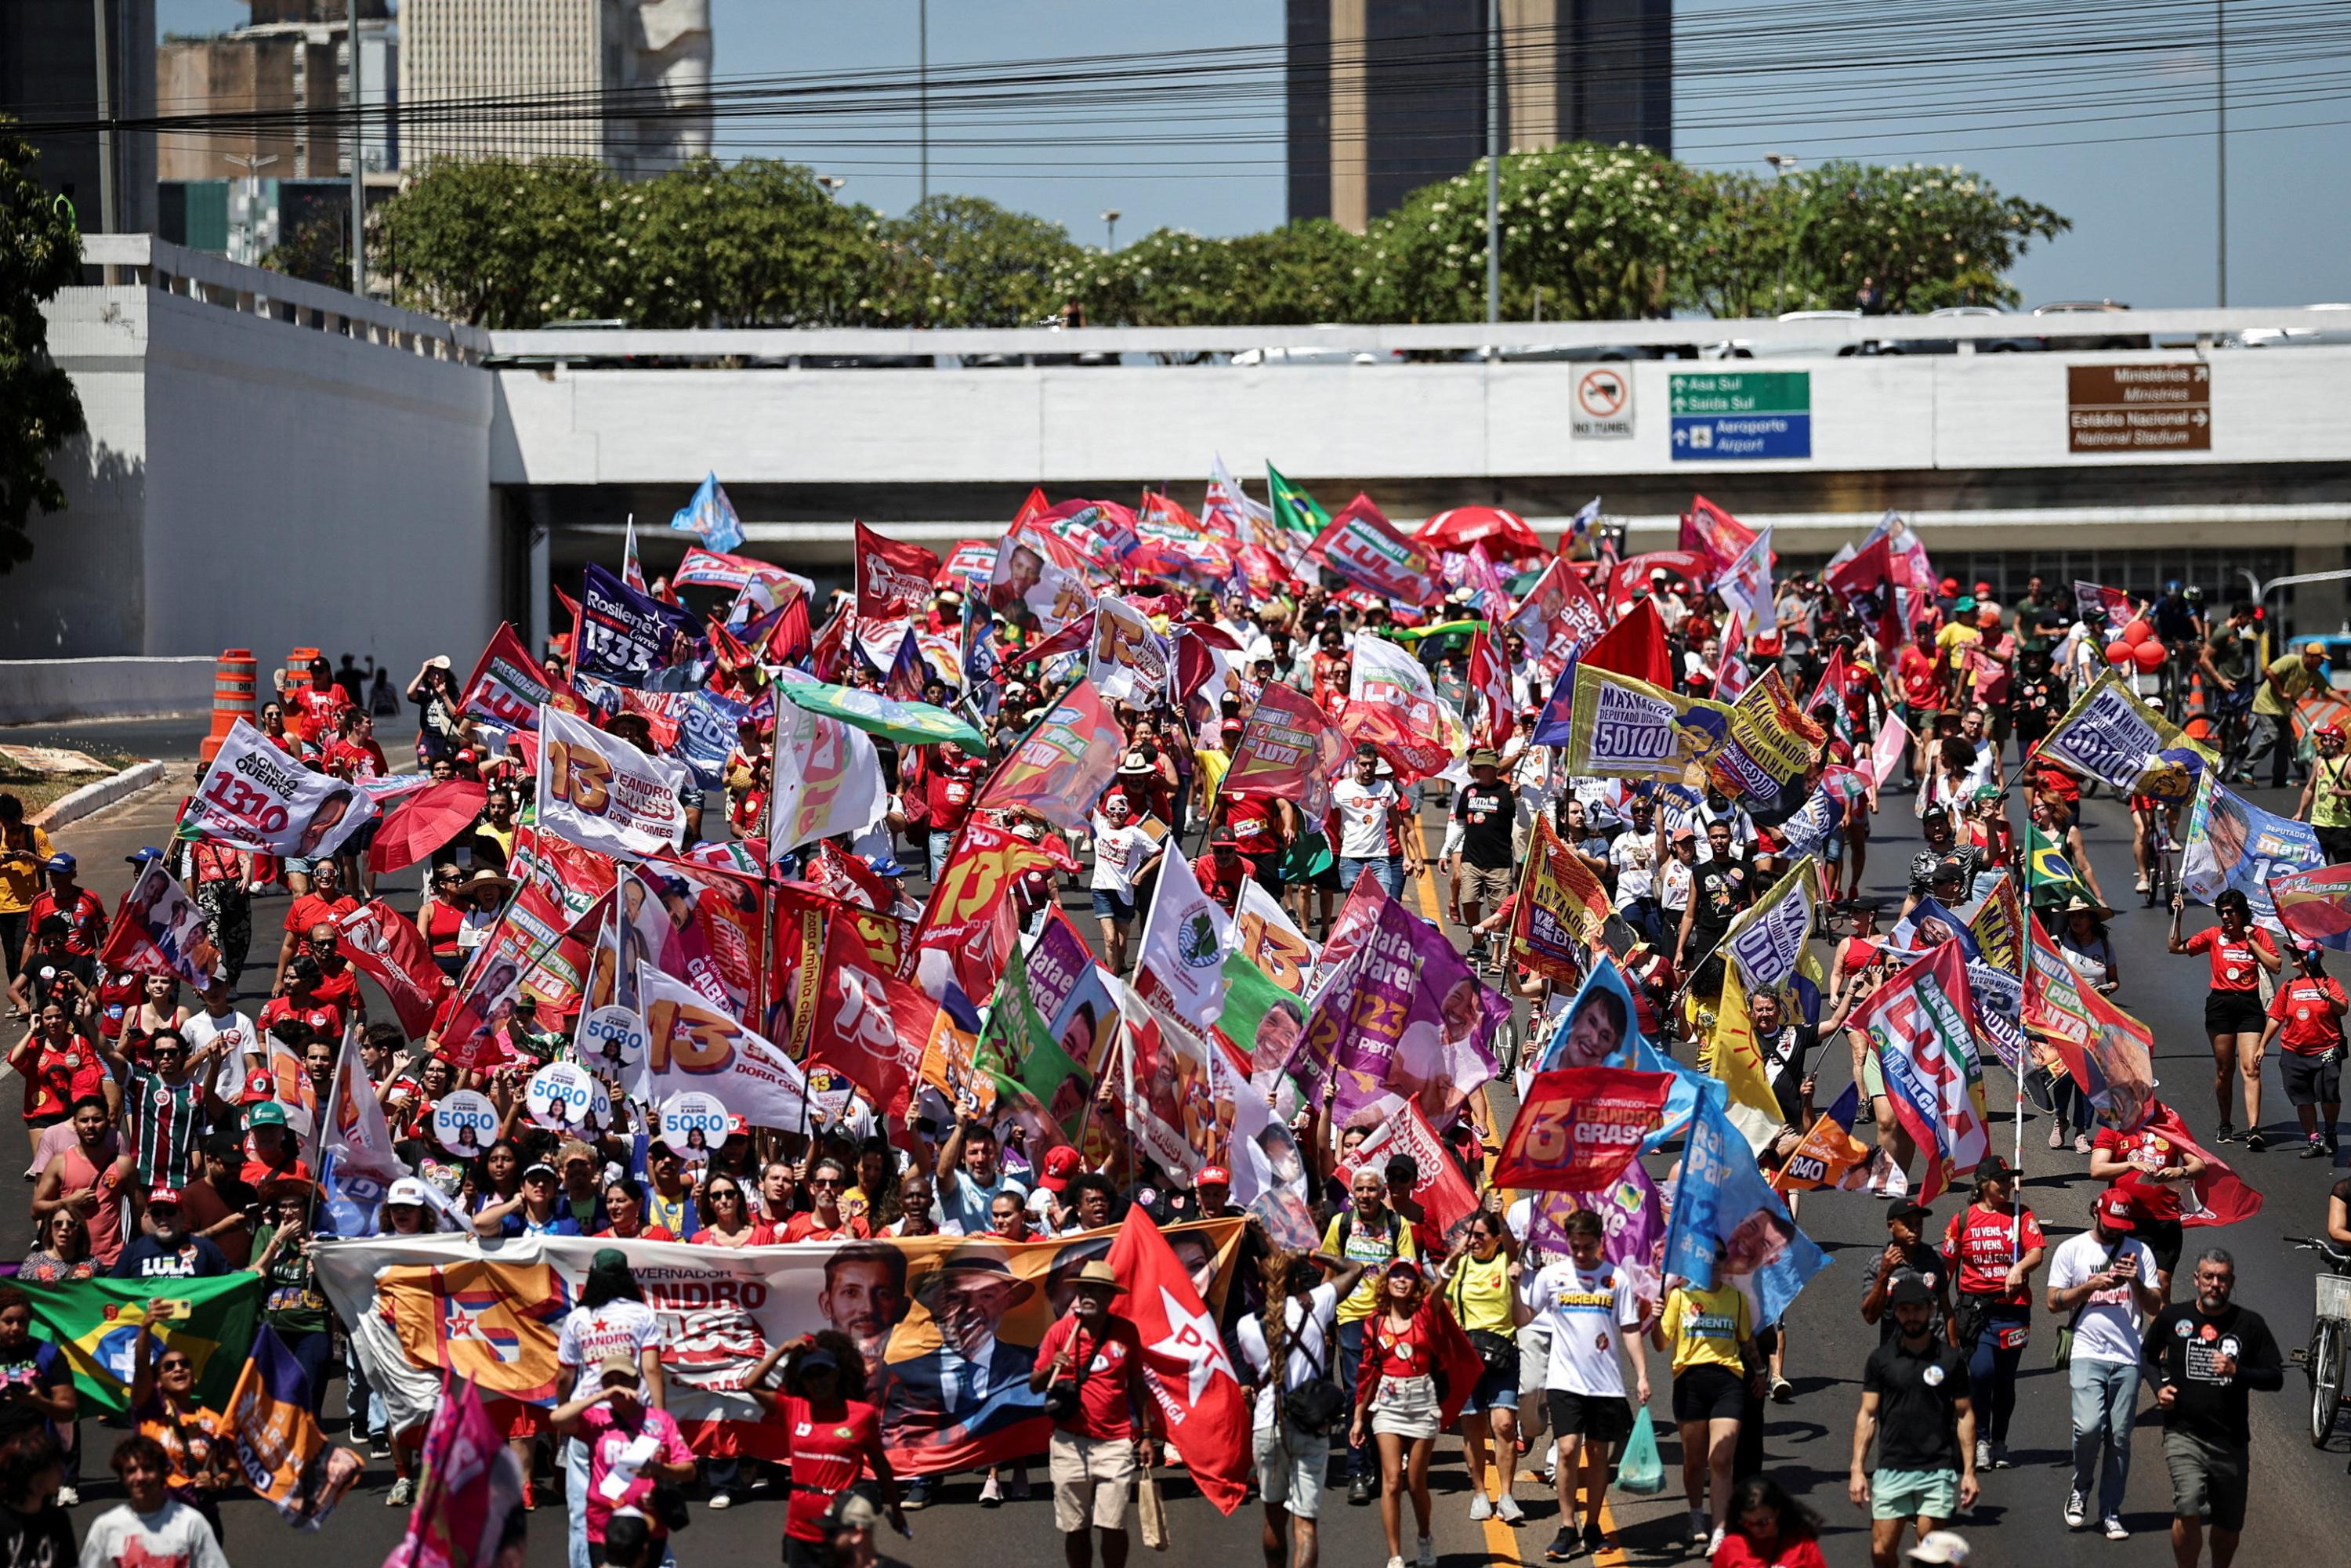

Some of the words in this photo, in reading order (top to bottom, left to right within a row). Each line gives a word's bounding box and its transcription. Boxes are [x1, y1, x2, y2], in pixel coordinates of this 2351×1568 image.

[1689, 378, 1715, 390] Asa
[1718, 377, 1741, 389] Sul
[2114, 368, 2190, 382] Ministérios
[1732, 397, 1754, 409] Sul
[2124, 387, 2190, 402] Ministries
[1716, 419, 1788, 435] Aeroporto
[2071, 411, 2125, 428] Estádio
[2127, 411, 2189, 426] Nacional
[1716, 437, 1764, 453] Airport
[2074, 430, 2132, 446] National
[2133, 429, 2189, 445] Stadium
[1333, 533, 1420, 601] LULA
[587, 589, 653, 634] Rosilene
[585, 619, 653, 672] 1333
[629, 630, 660, 650] Corrêa
[491, 657, 552, 704] PRESIDENTE
[476, 679, 533, 732] LUL
[1599, 709, 1639, 723] DEPUTADO
[1268, 727, 1313, 747] POPULAR
[1599, 724, 1671, 757] 50100
[2085, 710, 2117, 741] DEPUTADO
[2113, 734, 2148, 765] DISTRITAL
[2120, 716, 2157, 755] MACIEL
[1255, 742, 1300, 764] LUTA
[1736, 723, 1791, 784] MARAVILHAS
[2066, 723, 2139, 787] 50100
[235, 759, 295, 801] QUEIROZ
[245, 751, 298, 791] AGNELO
[547, 740, 615, 817] 13
[614, 771, 673, 801] LEANDRO
[205, 771, 289, 834] 1310
[614, 785, 675, 821] GRASS
[1664, 790, 1691, 813] VOTE
[202, 807, 274, 854] FEDERAL
[609, 810, 633, 828] DORA
[636, 820, 674, 839] GOMES
[1234, 823, 1259, 835] LULA
[2265, 824, 2306, 840] DEPUTADO
[510, 907, 559, 946] COMIT
[808, 912, 817, 940] para
[808, 942, 817, 951] a
[1239, 911, 1312, 996] 13
[802, 953, 817, 998] minha
[1030, 944, 1077, 994] Rafae
[790, 1000, 810, 1055] cidade
[1350, 989, 1407, 1039] 123
[1918, 972, 1982, 1077] PRESIDENTE
[587, 1020, 643, 1048] 5080
[648, 998, 744, 1077] 13
[735, 1063, 777, 1085] DORA
[1882, 1048, 1908, 1079] VICE
[533, 1080, 587, 1106] 5080
[809, 1076, 831, 1092] 13
[438, 1111, 494, 1130] 5080
[665, 1115, 723, 1132] 5080
[1509, 1099, 1574, 1168] 13
[151, 1189, 176, 1200] LULA
[1970, 1227, 1981, 1237] TU
[1982, 1226, 2003, 1237] VENS,
[1972, 1241, 1982, 1251] TU
[1982, 1240, 2004, 1252] VENS,
[1983, 1251, 1994, 1264] JÁ
[142, 1257, 195, 1276] LULA
[1558, 1293, 1614, 1309] PARENTE
[1682, 1318, 1734, 1330] PARENTE
[1176, 1323, 1223, 1367] PT
